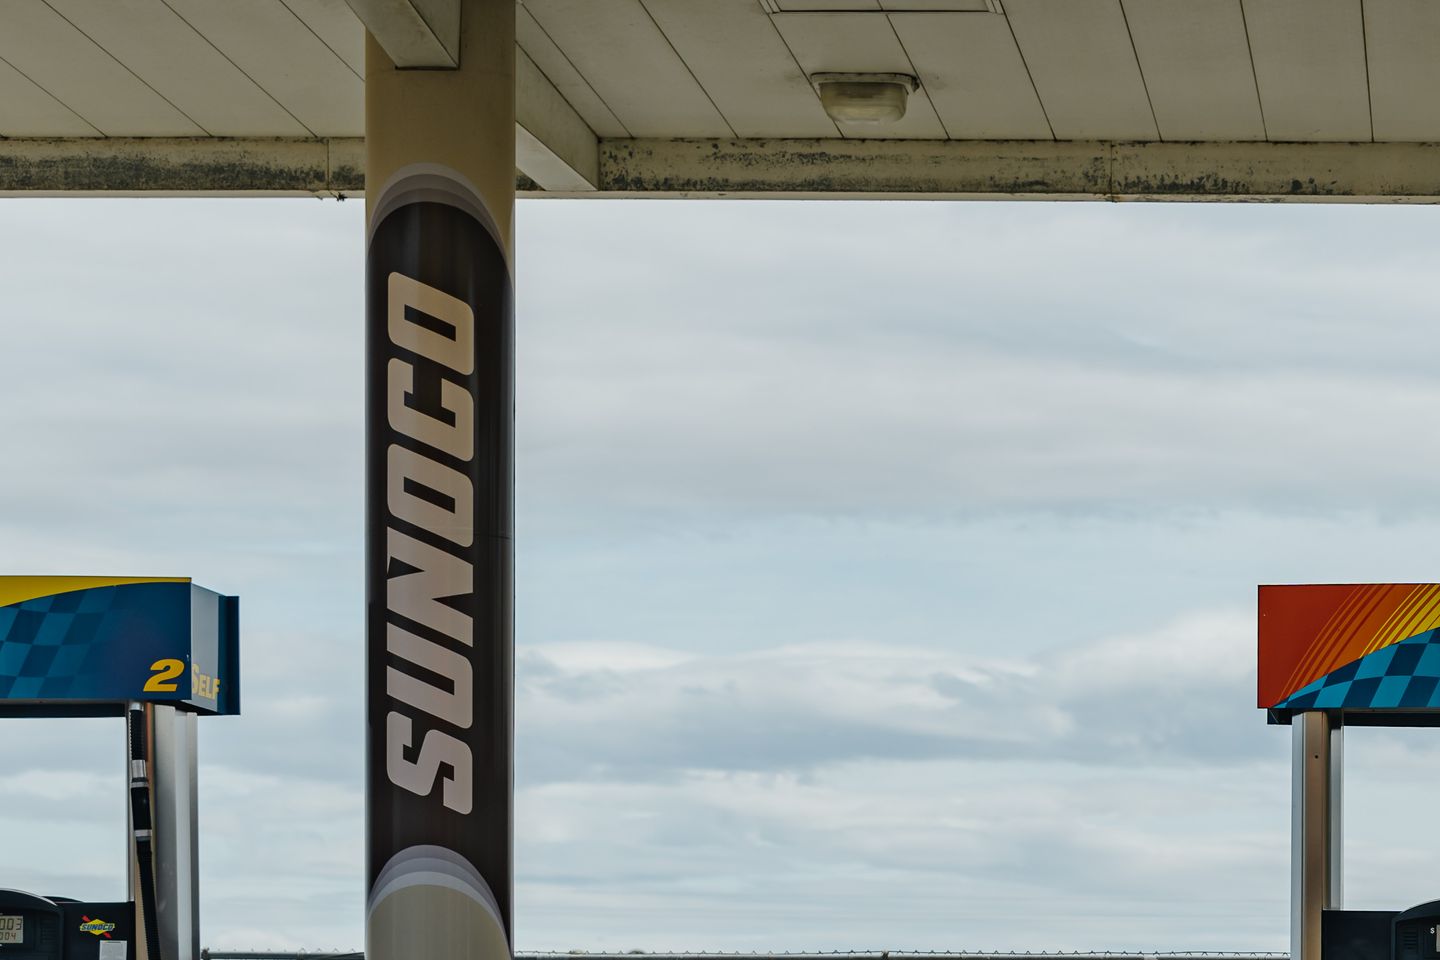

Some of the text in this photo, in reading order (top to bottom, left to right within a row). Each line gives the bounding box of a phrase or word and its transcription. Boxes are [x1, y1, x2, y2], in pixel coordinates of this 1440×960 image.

[387, 271, 475, 815] SUNOCO
[143, 658, 185, 692] 2
[81, 923, 114, 932] SUNOCO
